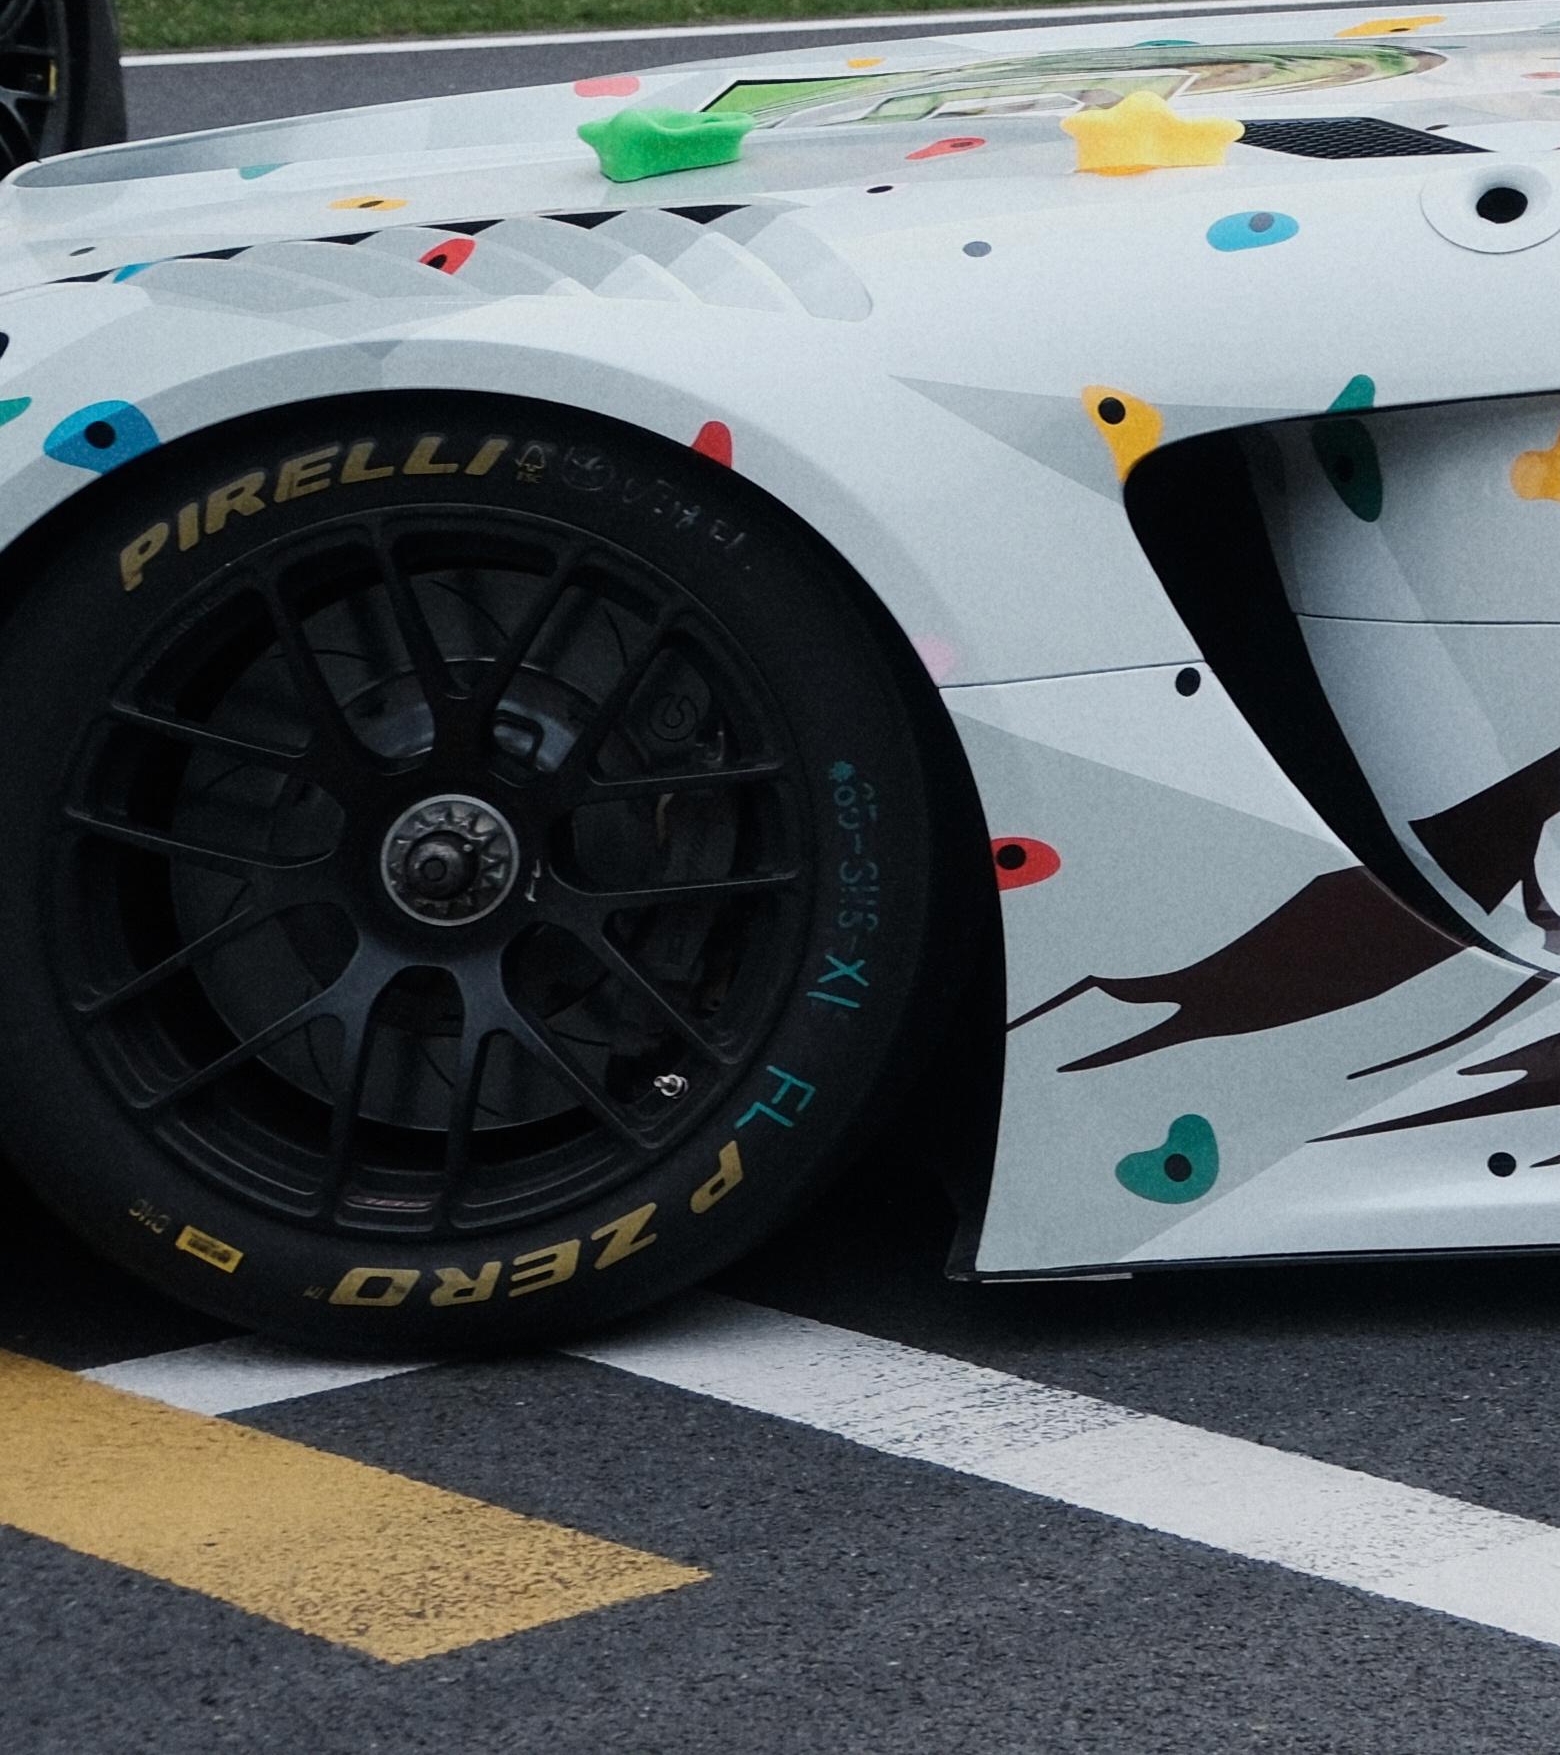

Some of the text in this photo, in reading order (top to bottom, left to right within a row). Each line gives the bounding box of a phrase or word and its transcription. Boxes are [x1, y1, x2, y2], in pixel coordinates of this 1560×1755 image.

[118, 435, 508, 593] PIRELLI
[734, 1064, 817, 1131] FL
[689, 1138, 750, 1221] P
[329, 1205, 664, 1308] ZERO
